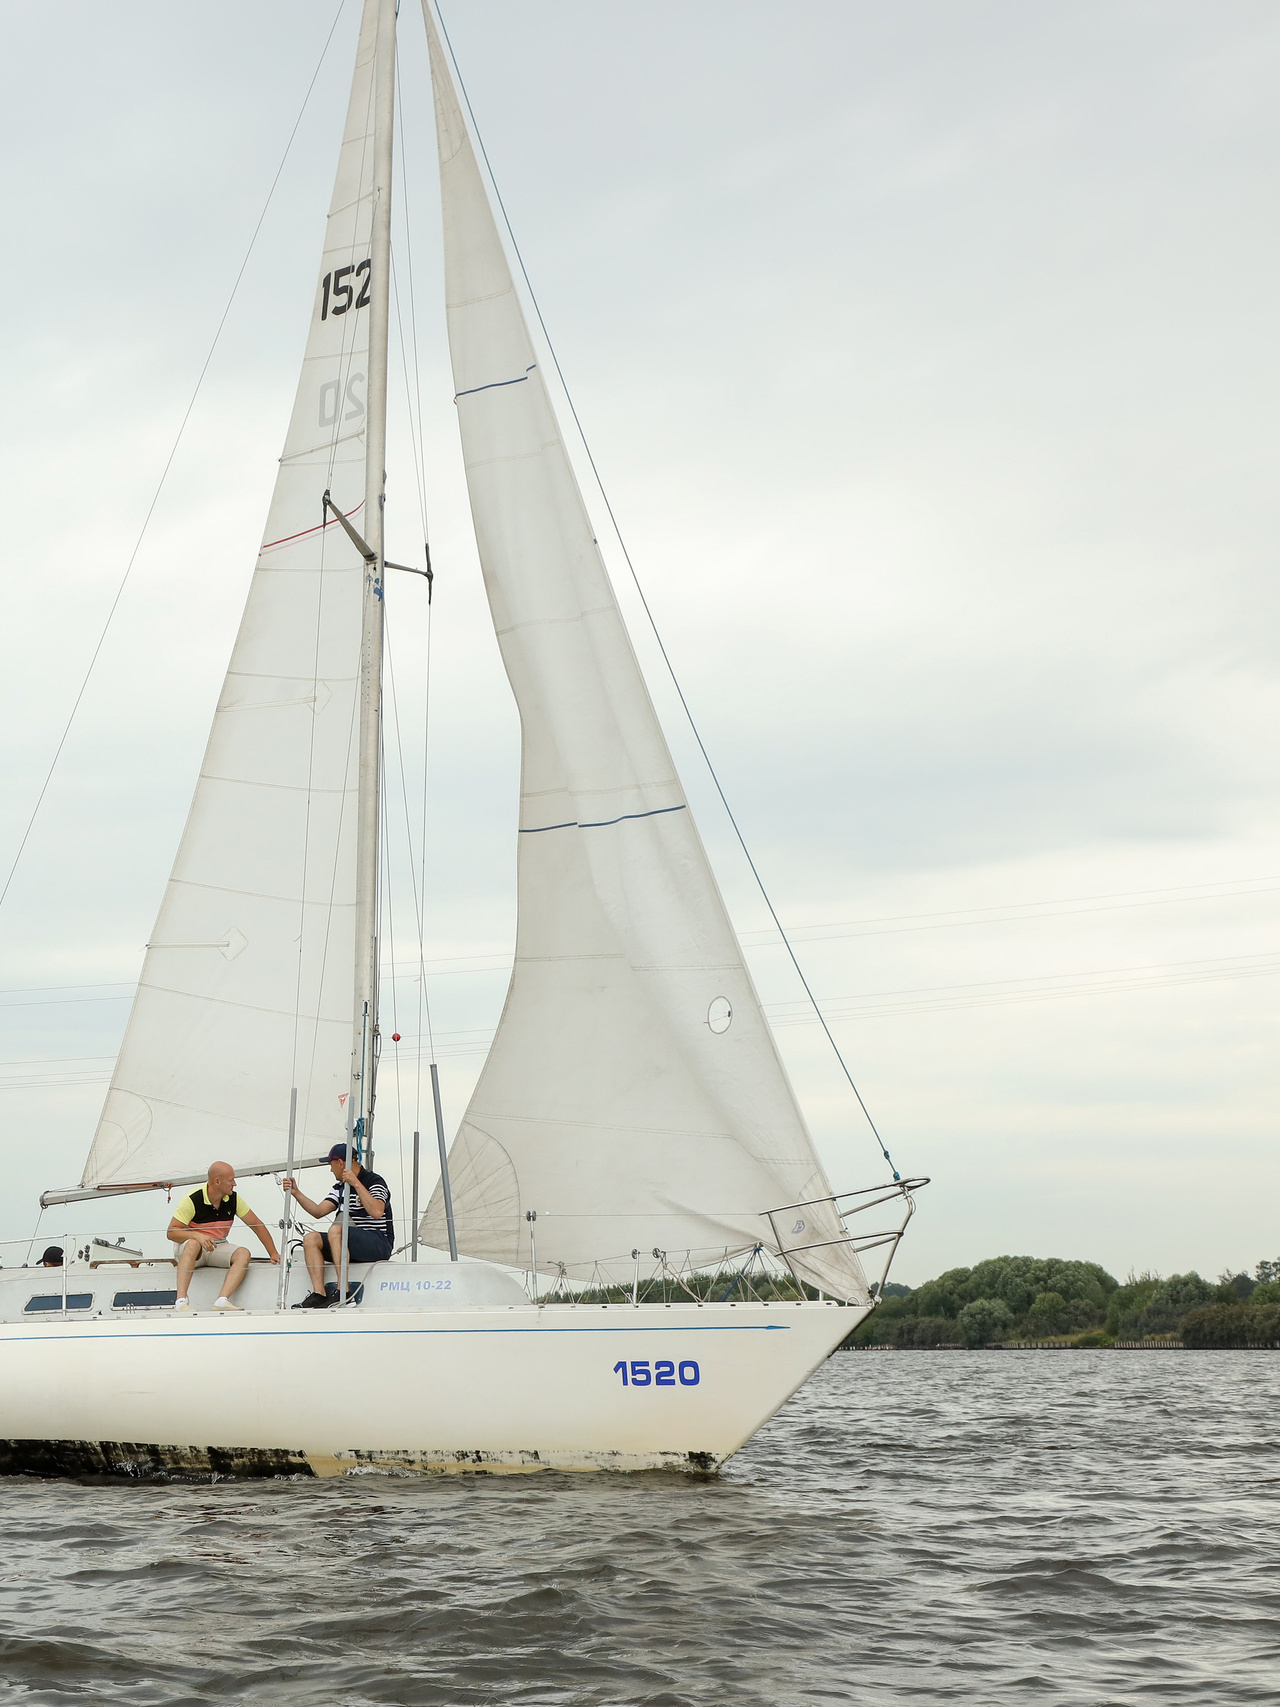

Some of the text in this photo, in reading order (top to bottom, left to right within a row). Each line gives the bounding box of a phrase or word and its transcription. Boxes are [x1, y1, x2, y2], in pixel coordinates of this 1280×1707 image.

[380, 1280, 452, 1292] РМЦ 10-22
[613, 1360, 700, 1386] 1520
